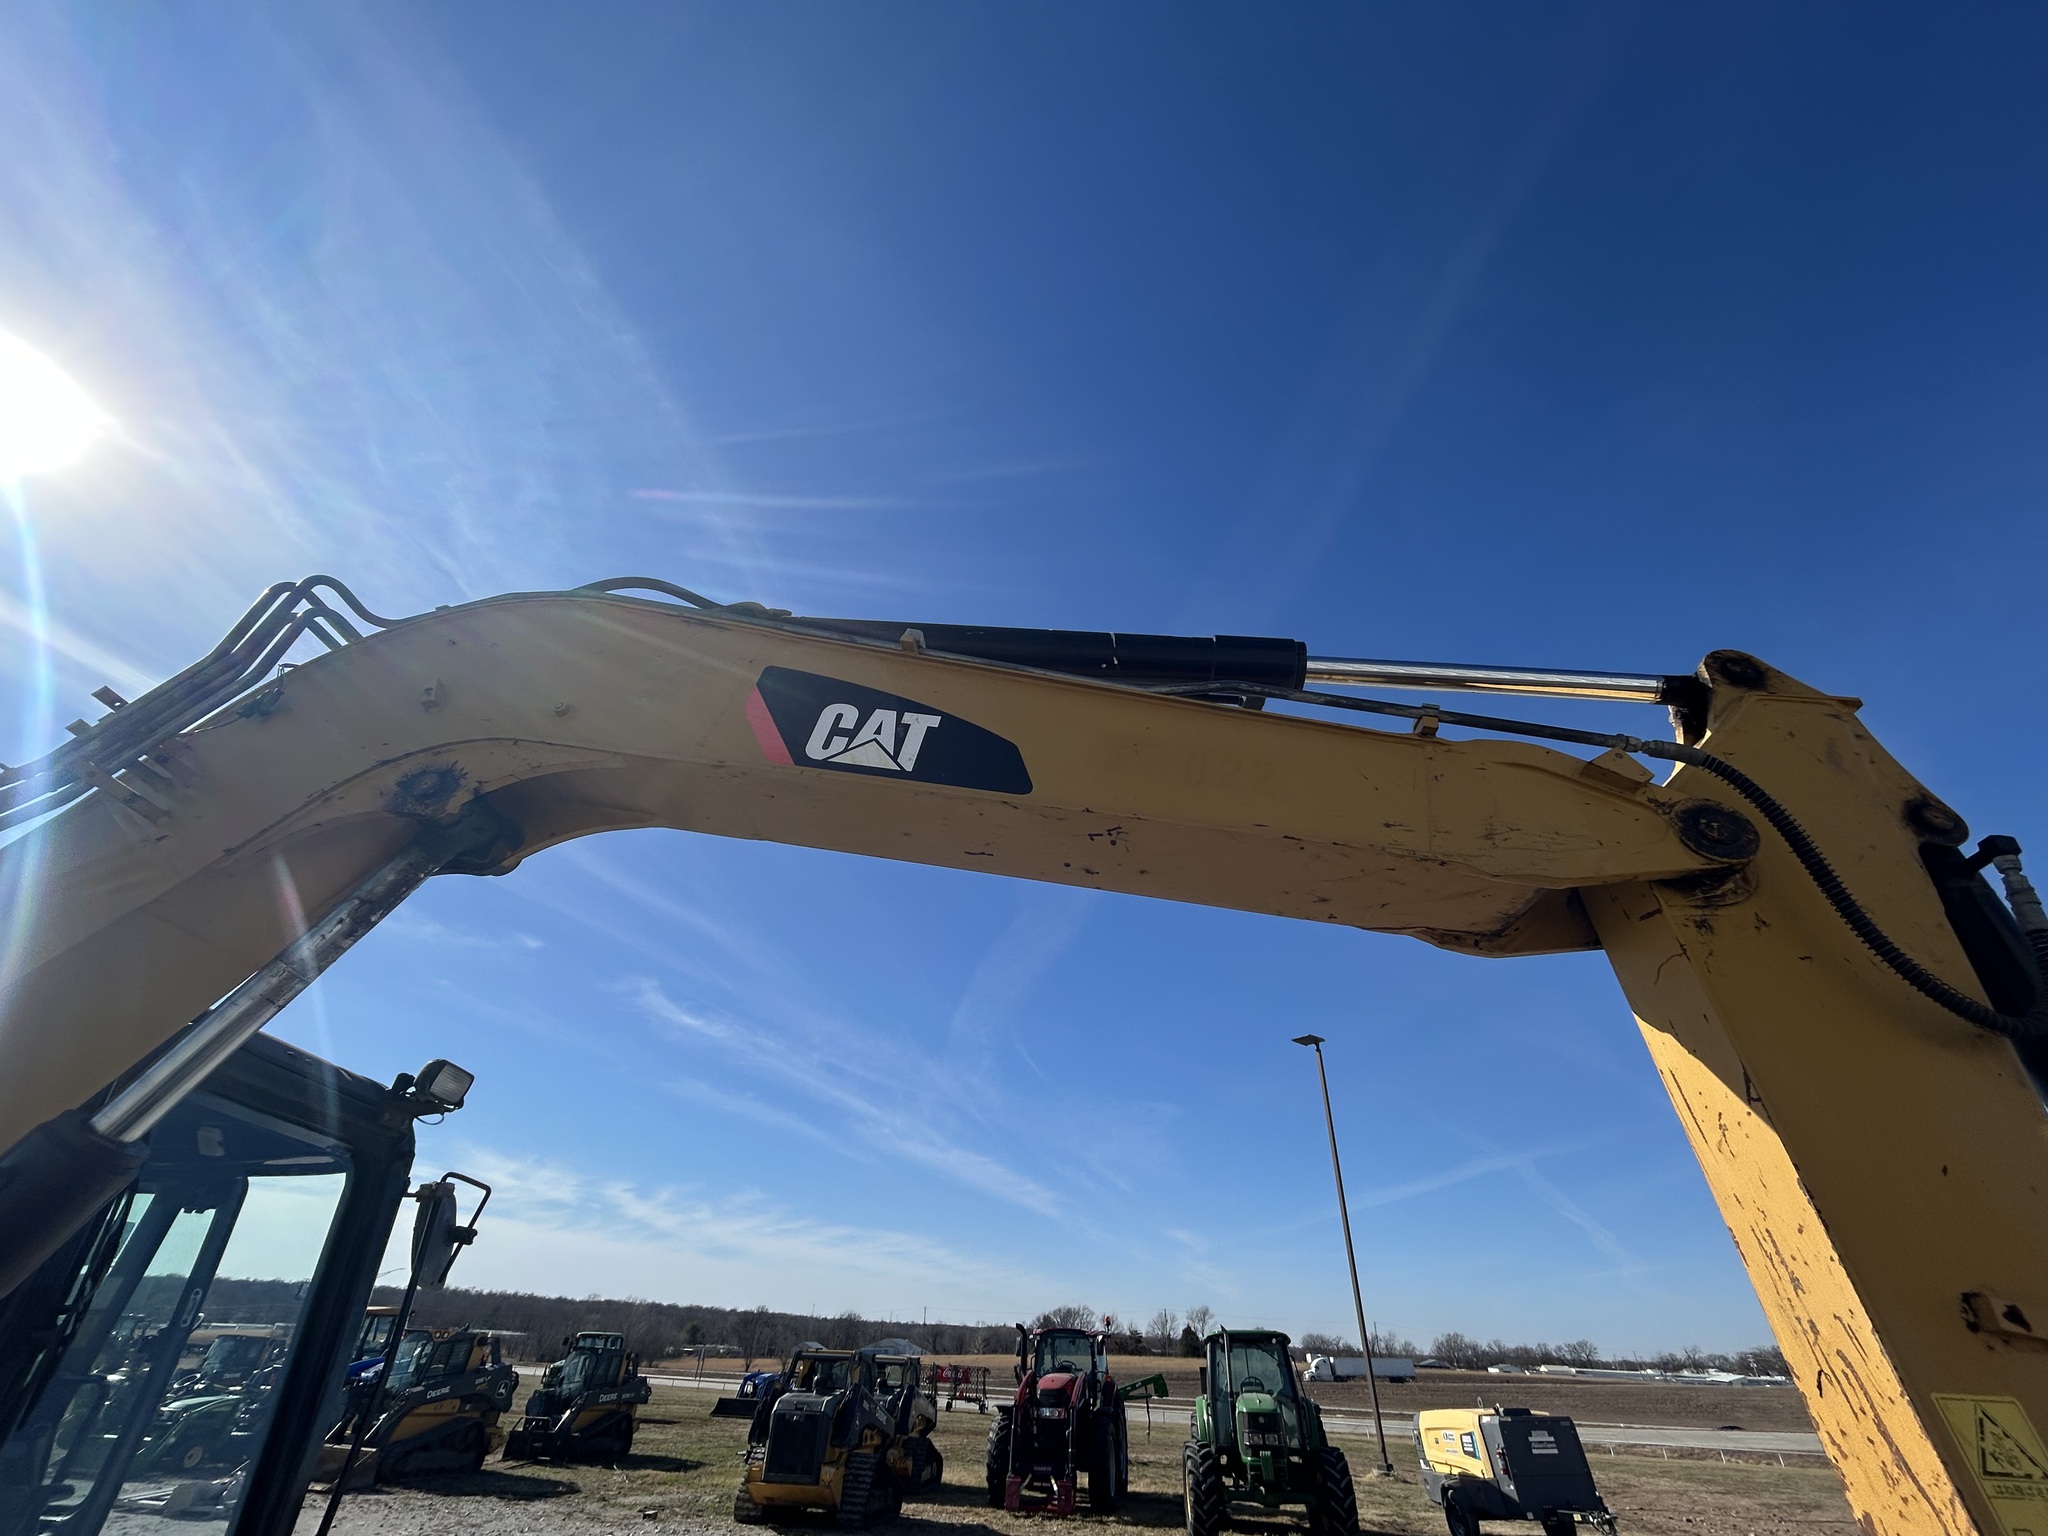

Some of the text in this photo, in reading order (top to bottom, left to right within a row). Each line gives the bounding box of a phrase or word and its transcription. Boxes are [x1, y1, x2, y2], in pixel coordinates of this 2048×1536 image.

[805, 703, 942, 771] CAT
[426, 1385, 451, 1399] DEERE
[598, 1392, 618, 1403] DEERE
